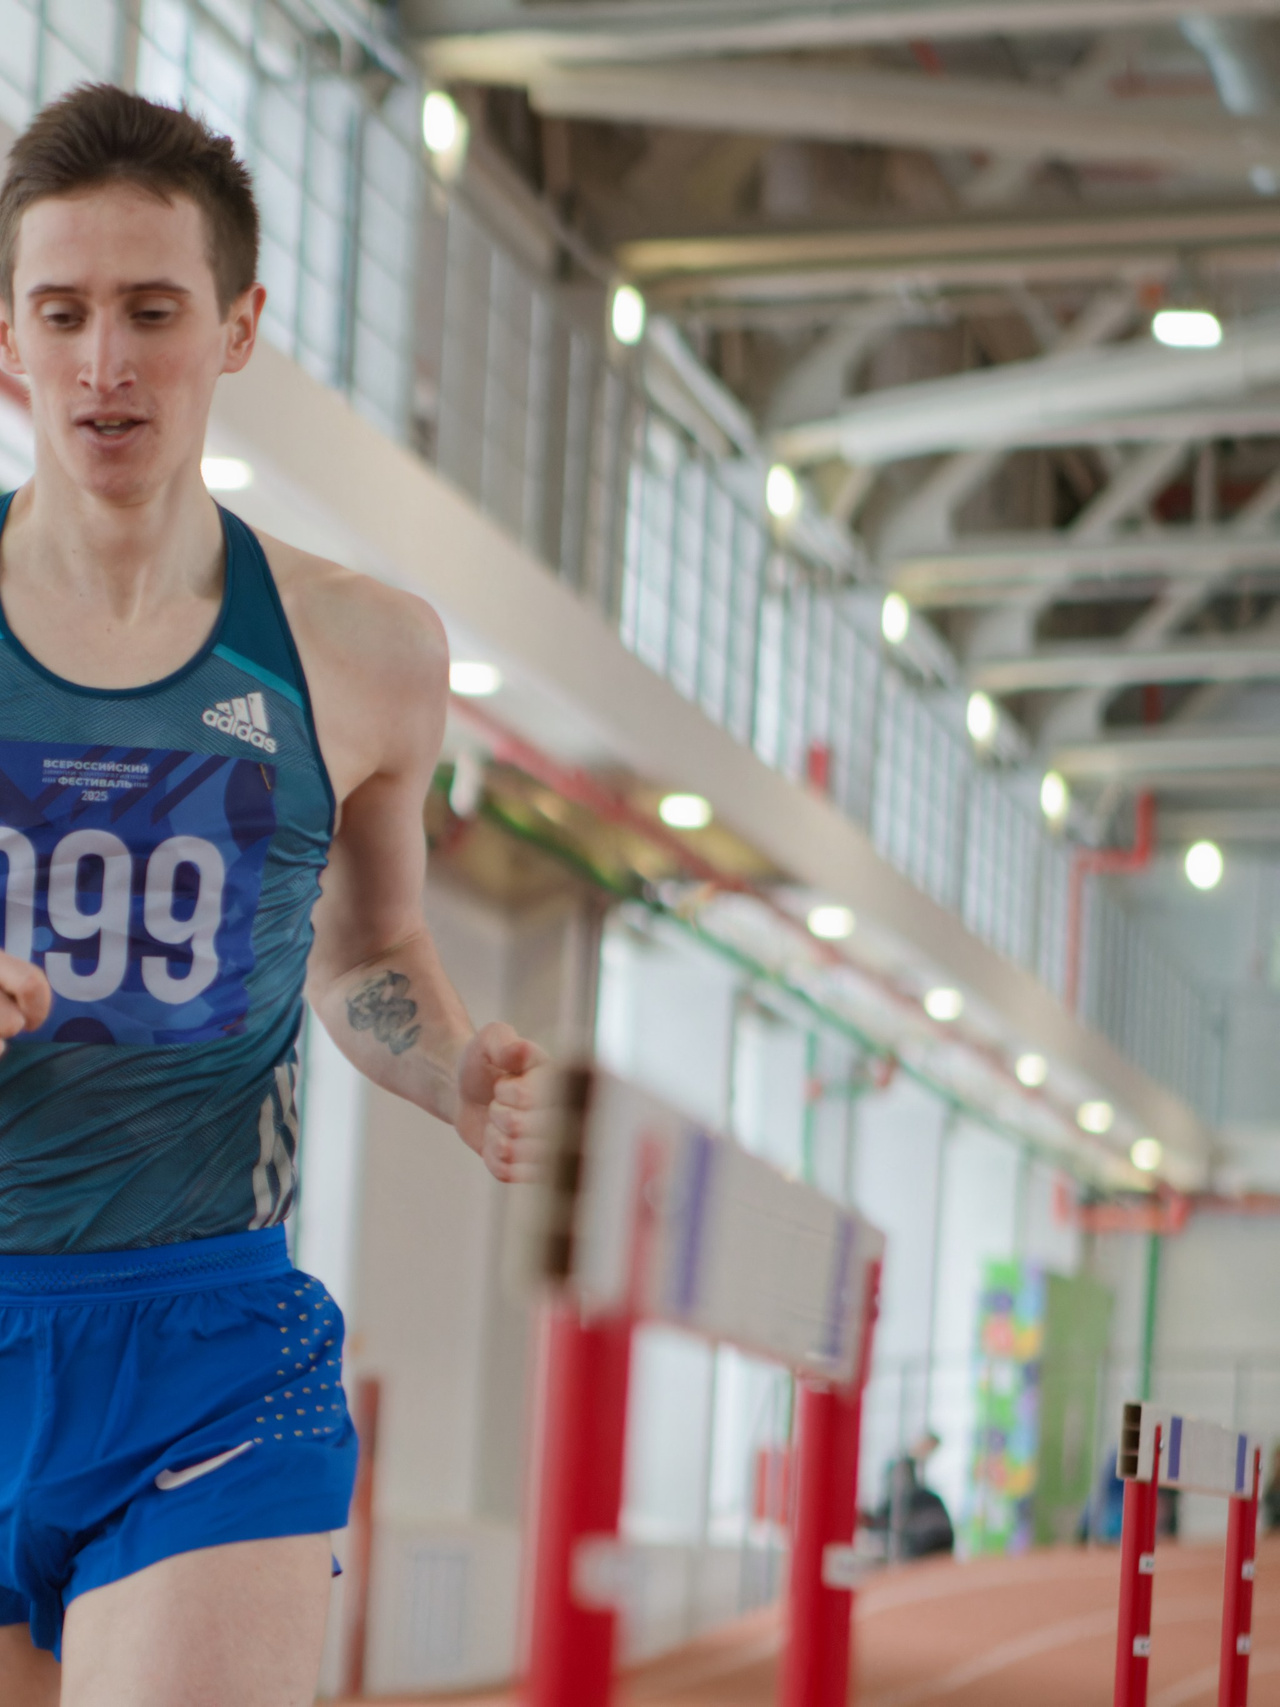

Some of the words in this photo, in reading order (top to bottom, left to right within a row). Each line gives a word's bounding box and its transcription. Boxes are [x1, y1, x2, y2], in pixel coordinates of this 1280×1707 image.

[201, 709, 277, 754] adidas
[42, 759, 149, 774] ВСЕРОССИЙСКИЙ
[57, 776, 133, 789] ФЕСТИВАЛЬ
[81, 790, 109, 802] 2025
